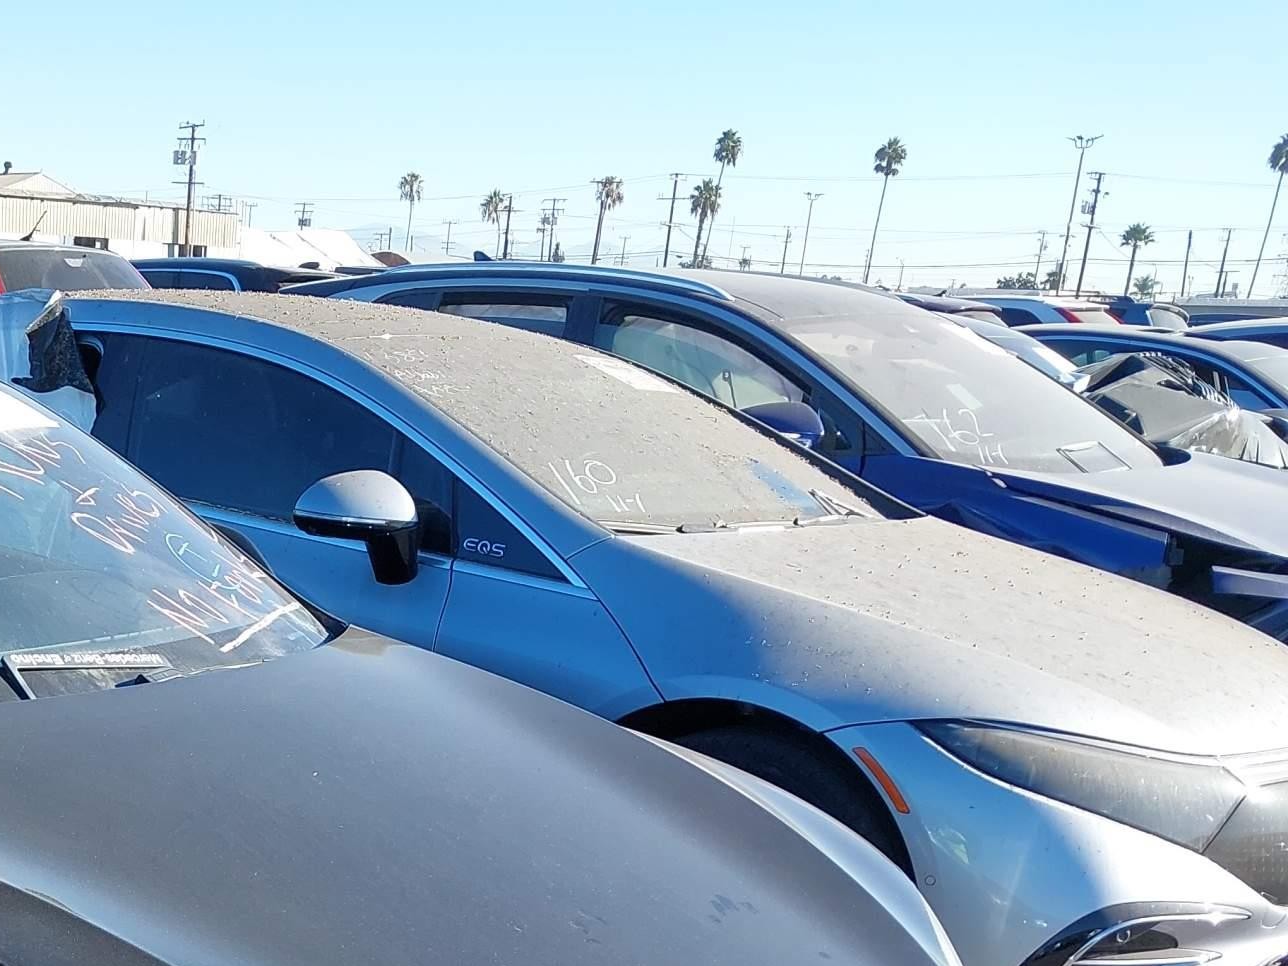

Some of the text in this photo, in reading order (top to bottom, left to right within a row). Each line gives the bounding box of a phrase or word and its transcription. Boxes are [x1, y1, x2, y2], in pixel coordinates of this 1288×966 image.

[547, 459, 617, 505] 160
[463, 537, 507, 558] EQS
[10, 653, 64, 666] Encino
[71, 652, 163, 666] Mercedes-Benz
